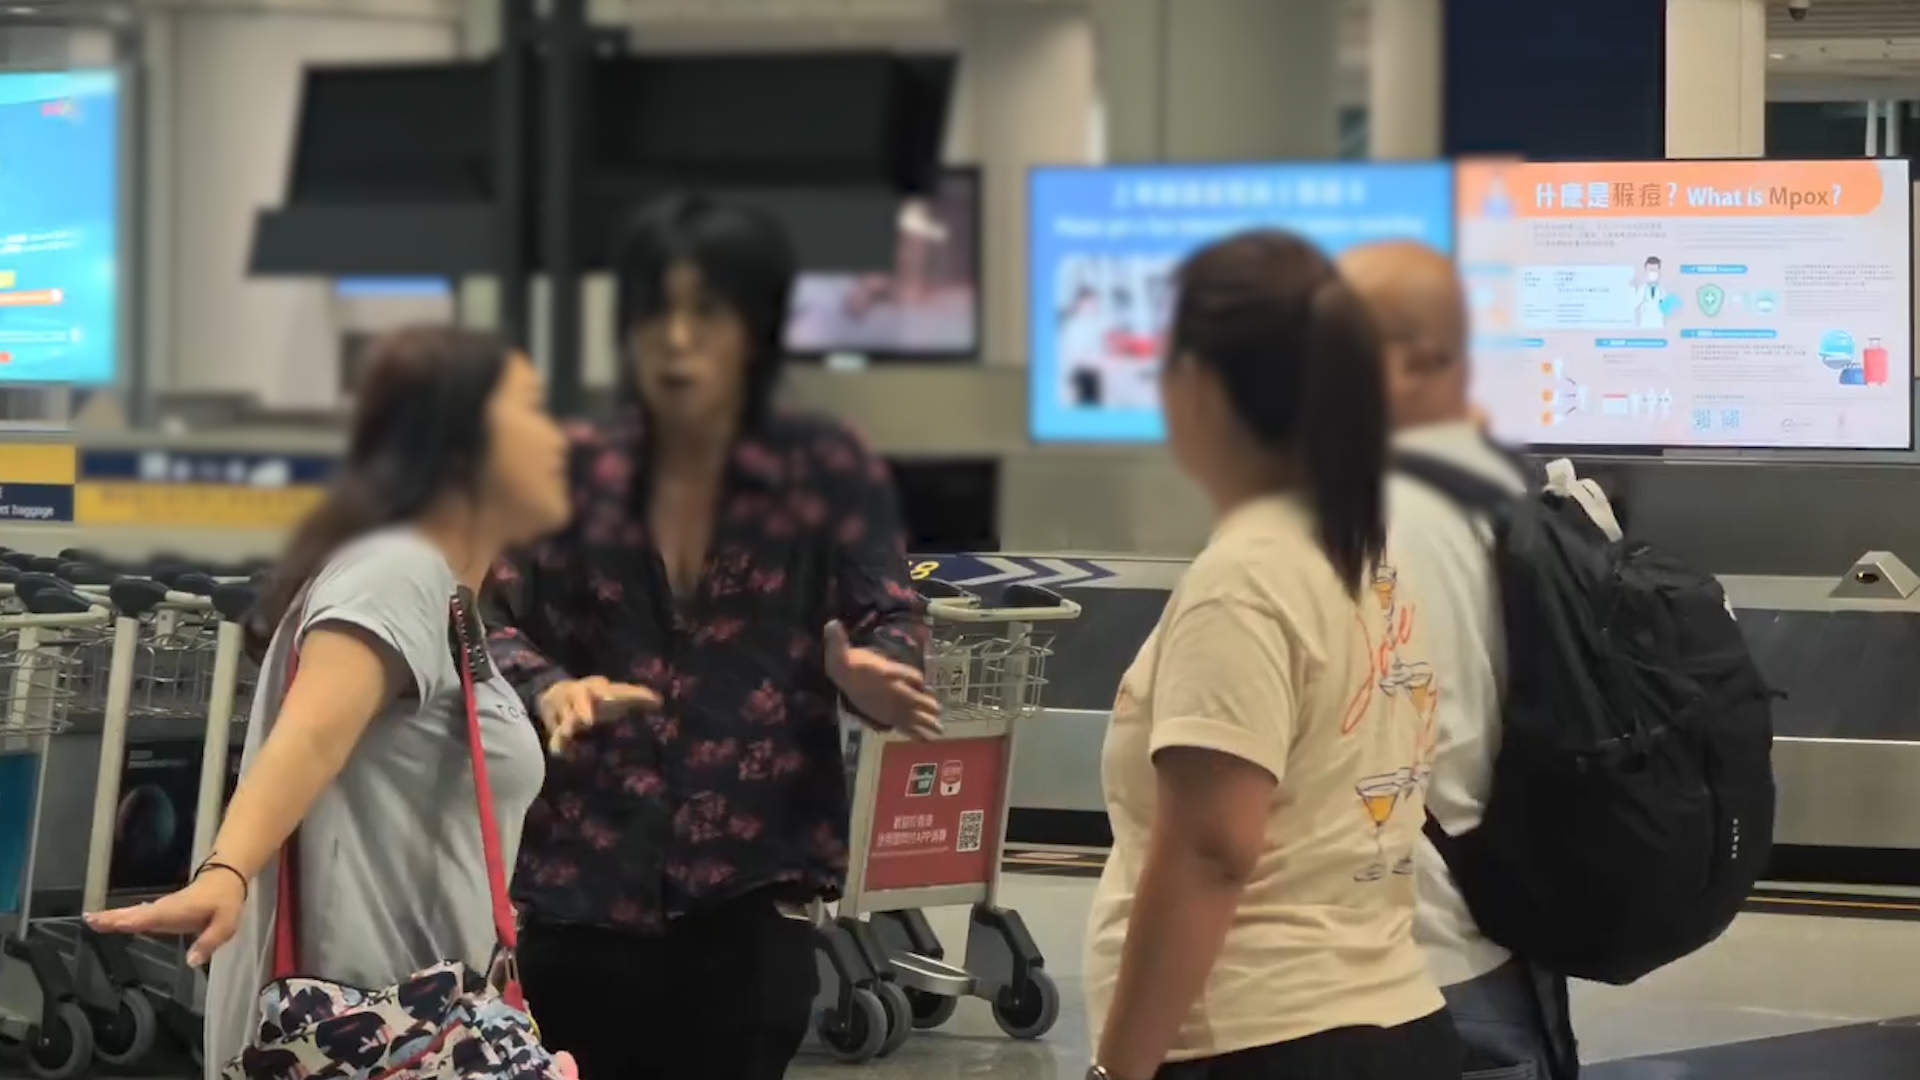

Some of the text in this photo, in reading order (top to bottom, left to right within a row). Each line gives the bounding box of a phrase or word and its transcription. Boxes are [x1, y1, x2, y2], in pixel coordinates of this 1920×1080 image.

[1687, 186, 1743, 208] What
[1748, 186, 1764, 208] is
[1769, 184, 1843, 211] Mpox?
